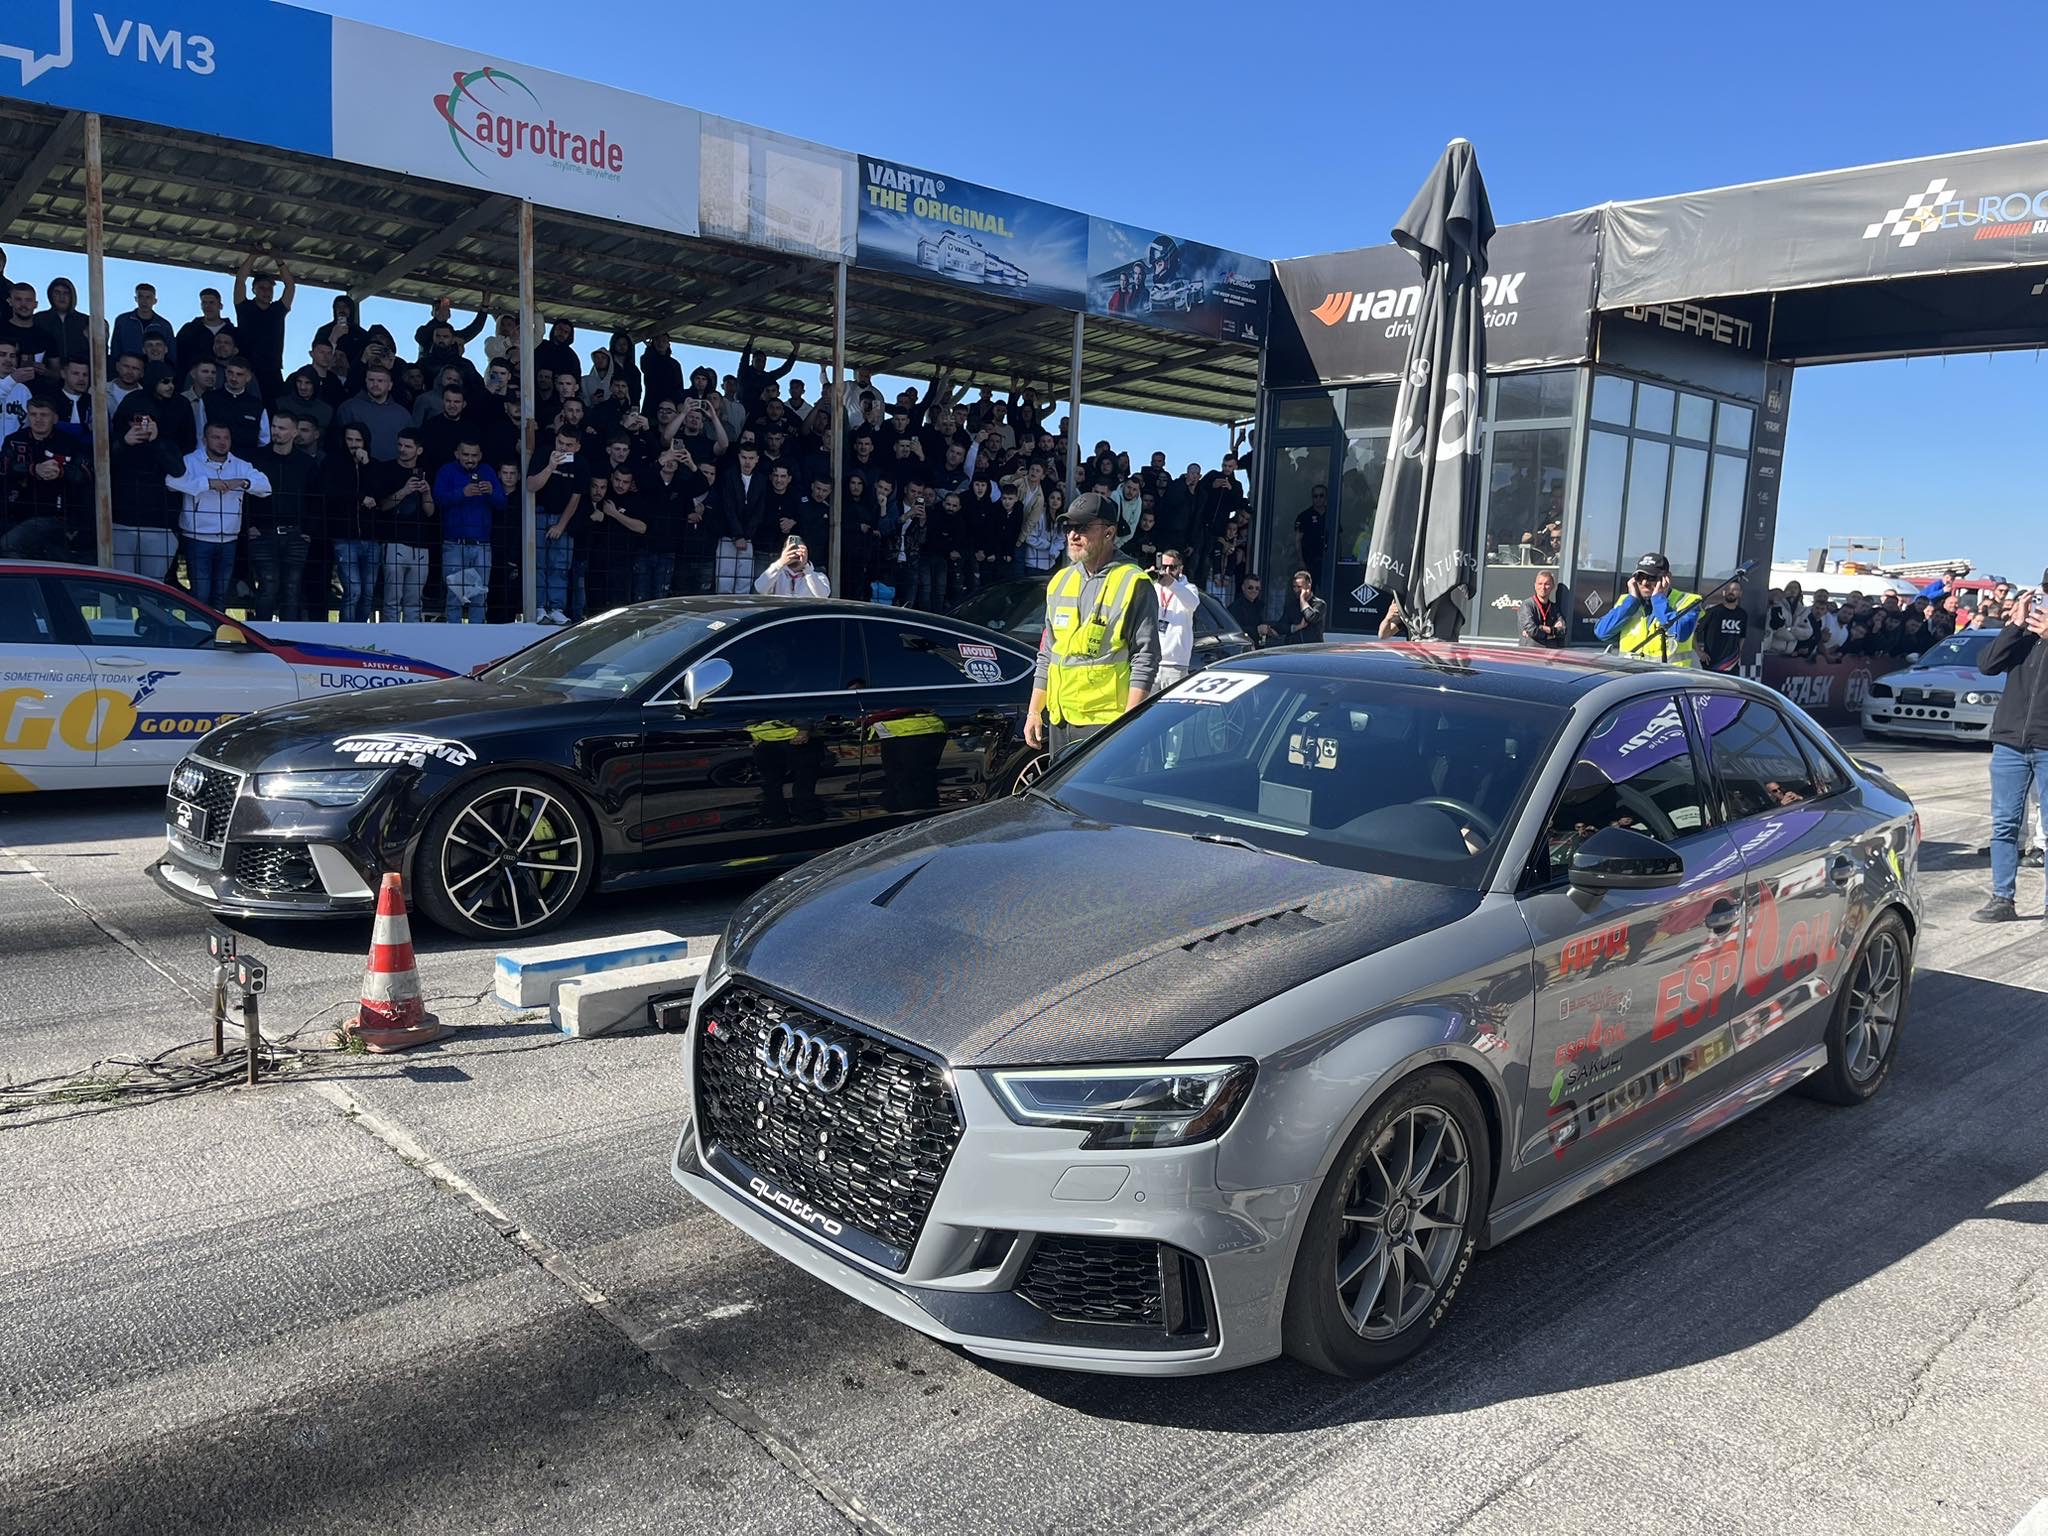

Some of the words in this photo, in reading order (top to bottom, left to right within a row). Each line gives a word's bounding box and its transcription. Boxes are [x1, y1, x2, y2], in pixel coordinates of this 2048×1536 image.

[93, 12, 215, 75] VM3
[476, 111, 623, 173] agrotrade
[586, 166, 621, 183] anywhere
[867, 184, 908, 213] THE
[913, 197, 1014, 239] ORIGINAL.
[1721, 619, 1741, 631] KK
[962, 646, 994, 658] MOTUL
[3, 671, 63, 682] SOMETHING
[66, 672, 98, 683] GREAT
[362, 661, 390, 670] SAFETY
[393, 664, 410, 672] CAR
[1184, 677, 1243, 695] 131
[0, 687, 137, 753] GO
[335, 742, 395, 753] AUTO
[396, 741, 469, 767] SERVIS
[1559, 920, 1631, 975] APR
[749, 1176, 842, 1236] quattro
